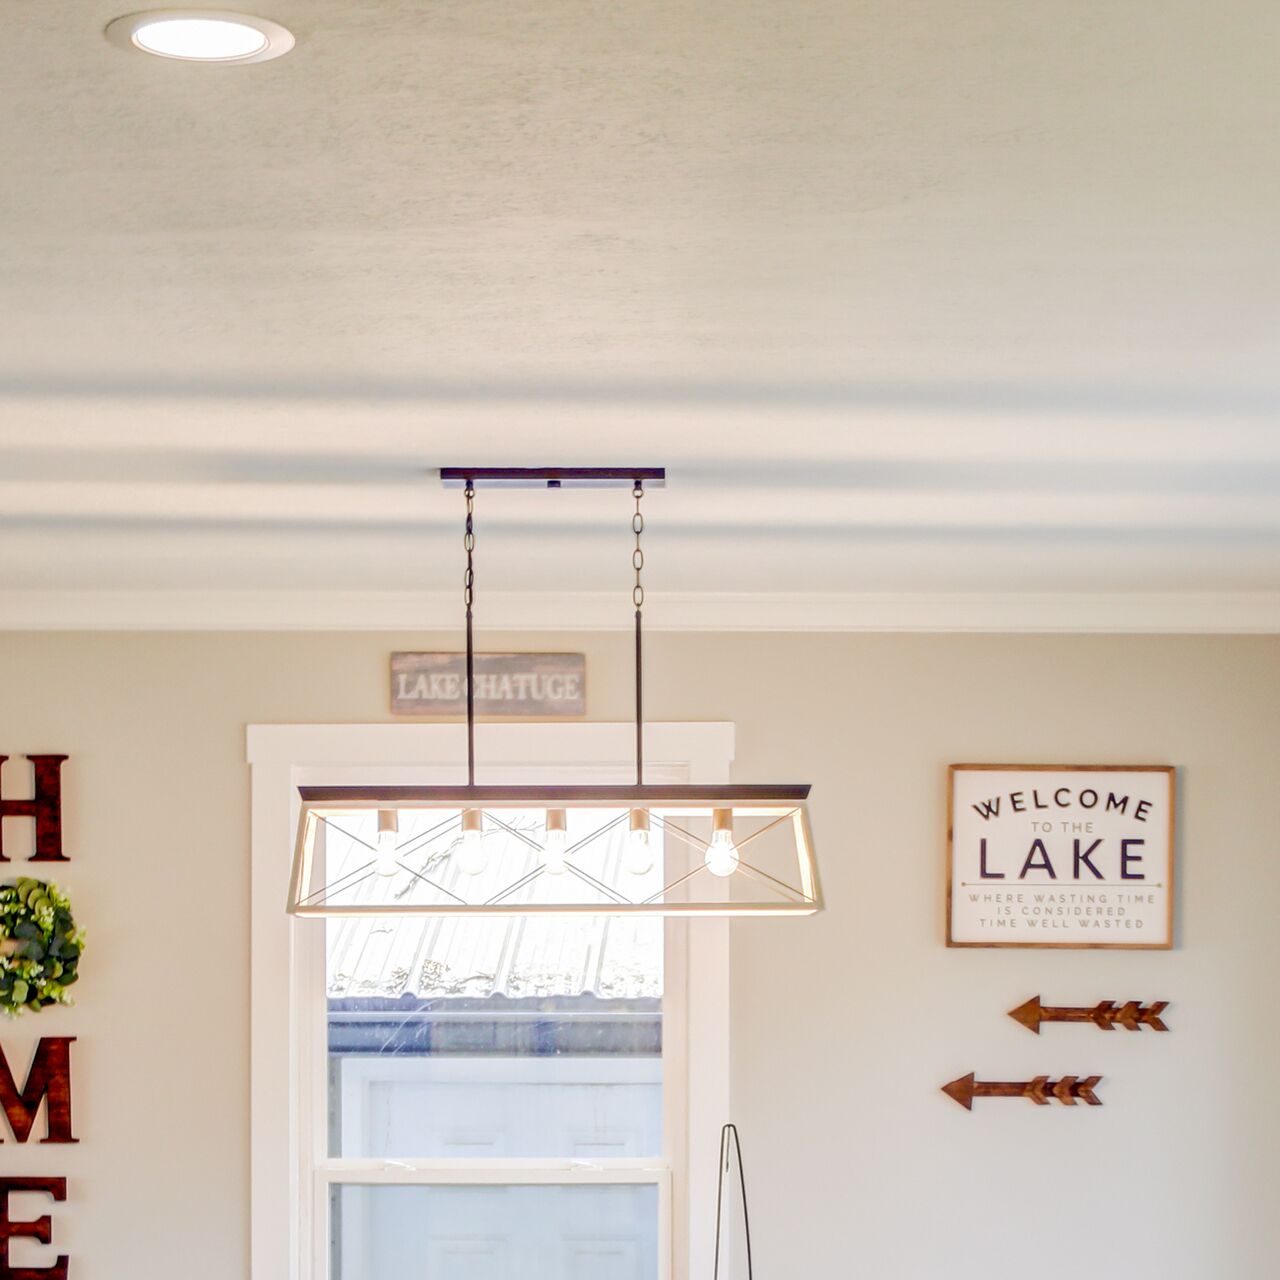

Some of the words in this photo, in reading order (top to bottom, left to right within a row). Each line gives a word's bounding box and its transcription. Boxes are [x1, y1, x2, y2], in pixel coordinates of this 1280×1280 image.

[397, 673, 460, 700] LAKE
[971, 787, 1153, 822] WELCOME
[1031, 822, 1053, 833] TO
[1061, 822, 1094, 834] THE
[979, 838, 1145, 880] LAKE
[969, 894, 1024, 903] WHERE
[1033, 894, 1108, 904] WASTING
[1117, 895, 1155, 904] TIME
[997, 906, 1012, 916] IS
[1021, 907, 1126, 916] CONSIDERED
[980, 918, 1017, 928] TIME
[1026, 919, 1069, 928] WELL
[1078, 919, 1144, 929] WASTED
